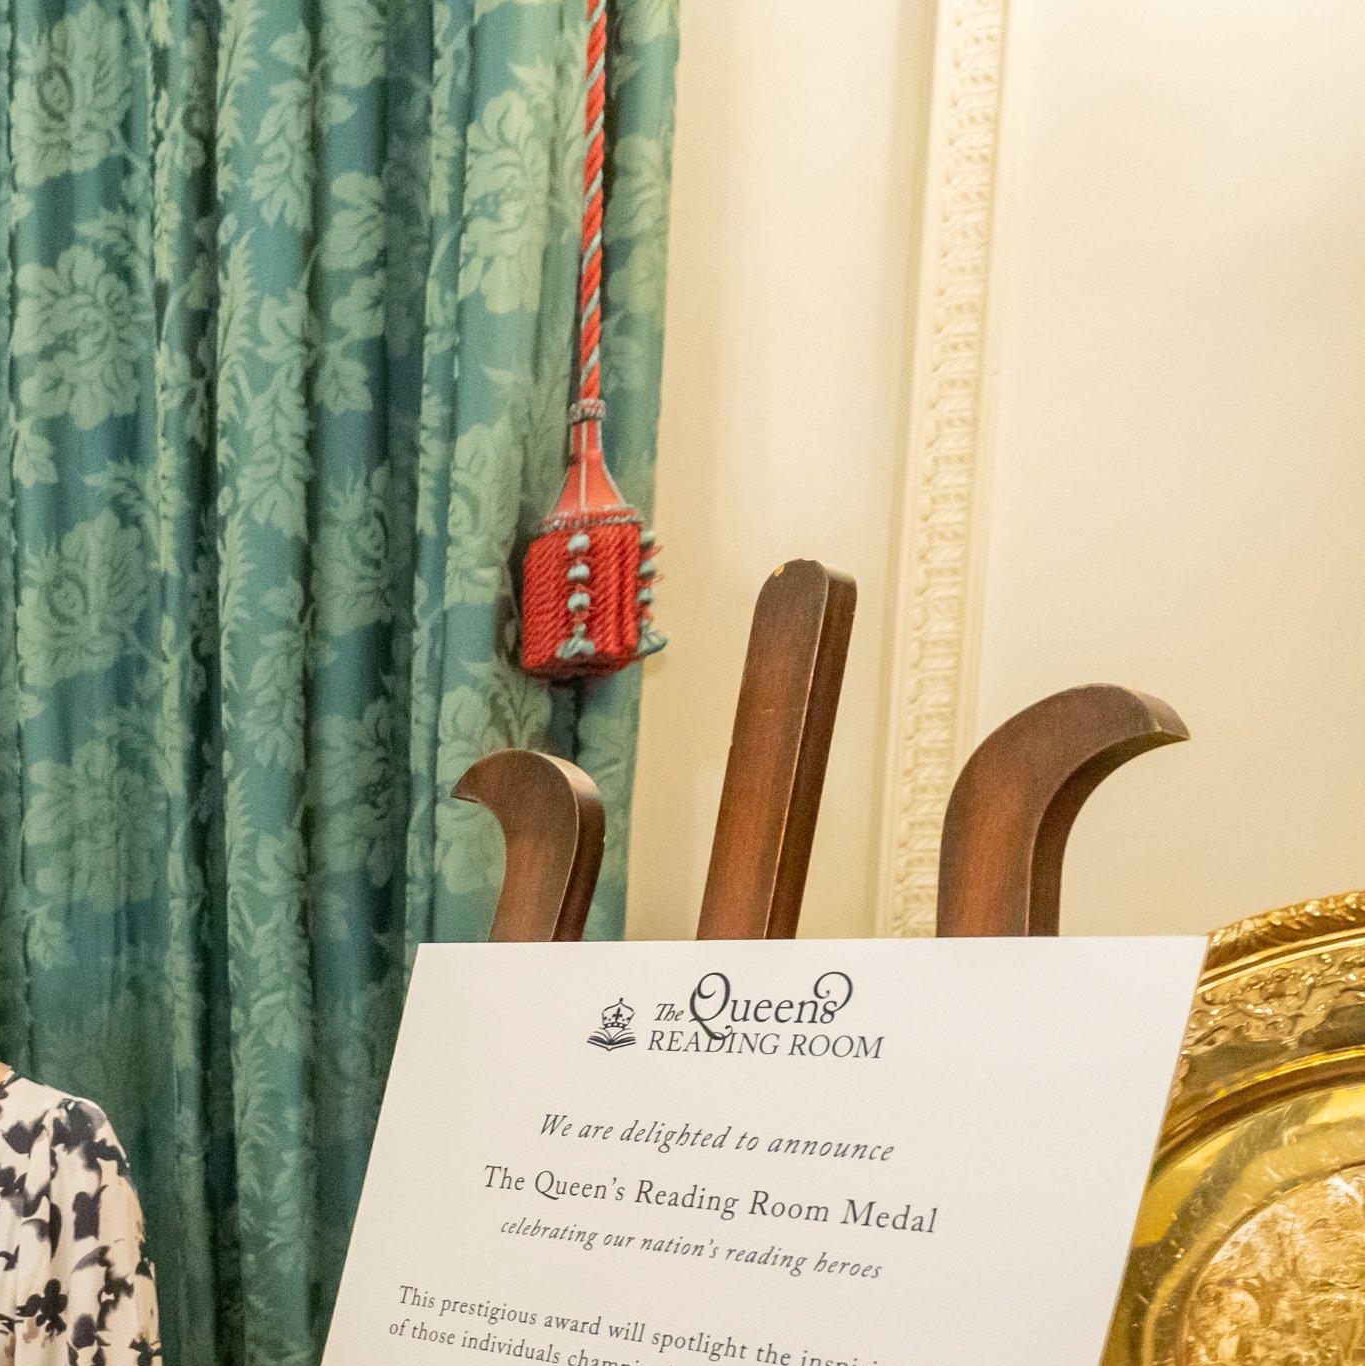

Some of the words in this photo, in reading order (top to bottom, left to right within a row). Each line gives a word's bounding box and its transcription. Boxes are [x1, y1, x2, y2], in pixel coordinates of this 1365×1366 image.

[654, 1003, 683, 1022] The
[647, 1030, 780, 1055] READING
[788, 1034, 885, 1059] ROOM
[540, 1114, 572, 1136] We
[578, 1125, 614, 1140] are
[620, 1120, 732, 1153] delighted
[735, 1132, 759, 1151] to
[767, 1138, 894, 1161] announce
[484, 1165, 525, 1191] The
[535, 1170, 625, 1201] Queen's
[634, 1180, 739, 1221] Reading
[748, 1190, 829, 1222] Room
[840, 1199, 938, 1233] Medal
[501, 1217, 598, 1250] celebrating
[603, 1234, 635, 1247] our
[640, 1236, 719, 1258] nation's
[725, 1246, 808, 1277] reading
[813, 1252, 882, 1278] heroes
[389, 1319, 410, 1336] of
[412, 1322, 455, 1345] those
[461, 1331, 560, 1364] individuals
[400, 1285, 435, 1308] This
[439, 1299, 537, 1325] prestigious
[544, 1316, 602, 1335] award
[608, 1322, 645, 1342] will
[652, 1332, 748, 1362] spotlight
[756, 1343, 791, 1366] the
